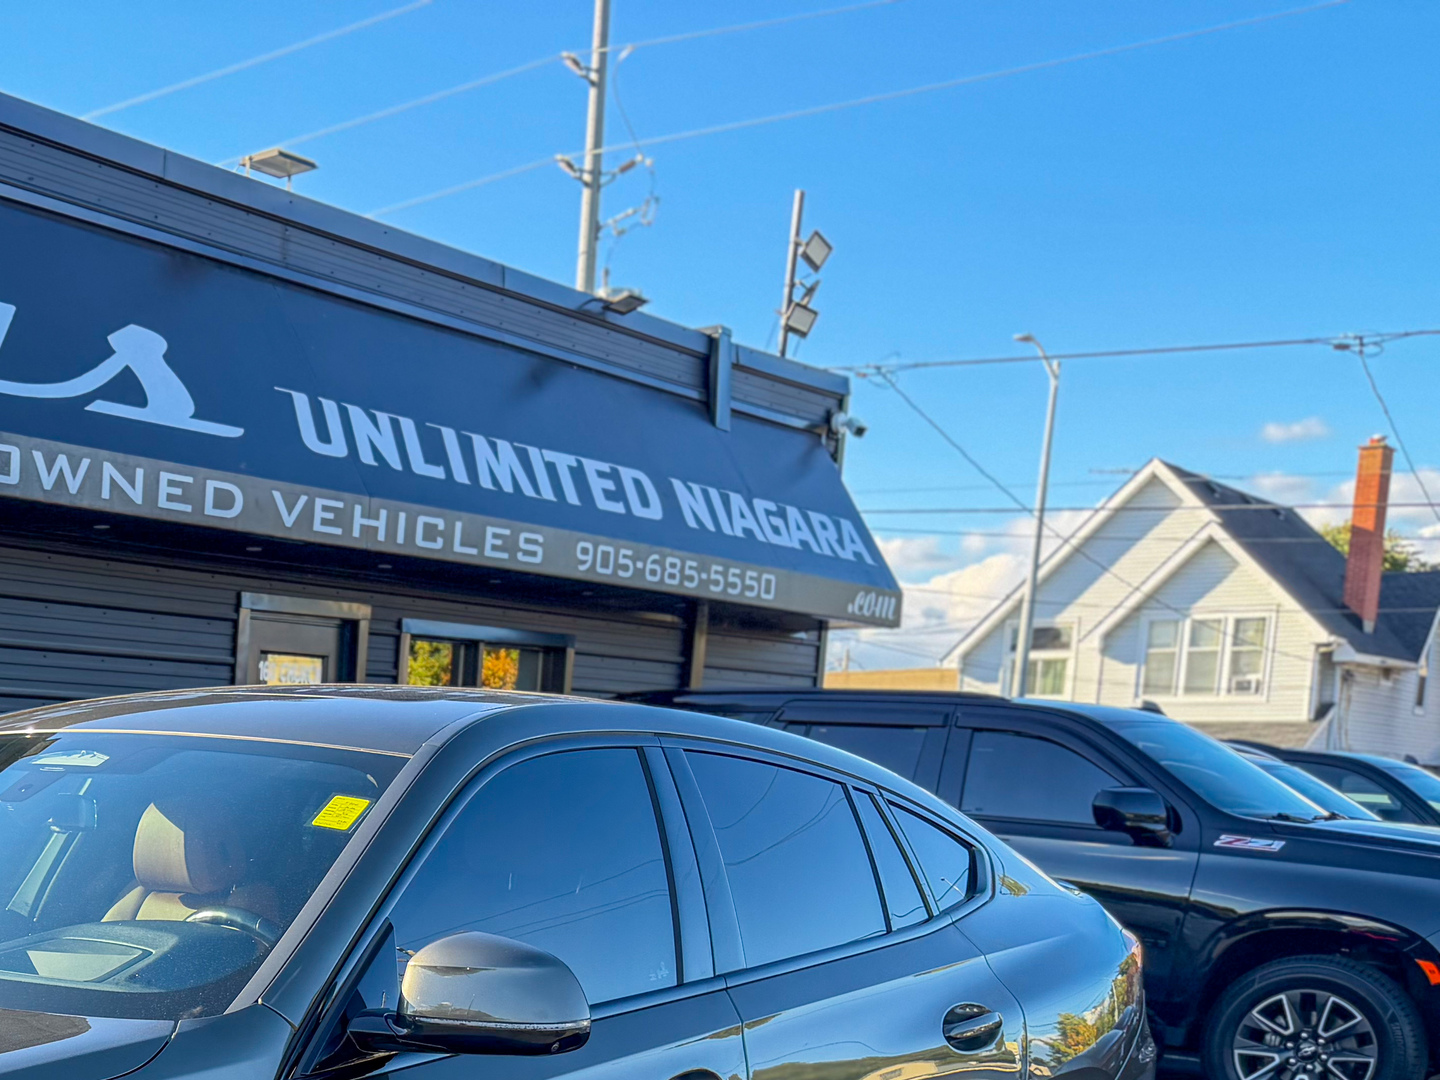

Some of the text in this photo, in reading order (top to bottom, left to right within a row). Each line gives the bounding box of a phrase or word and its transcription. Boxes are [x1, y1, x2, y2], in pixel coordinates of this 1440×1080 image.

[273, 386, 879, 567] UNLIMITED NIAGARA
[271, 489, 544, 564] VEHICLES
[575, 540, 777, 601] 905-685-5550
[847, 590, 898, 621] .com
